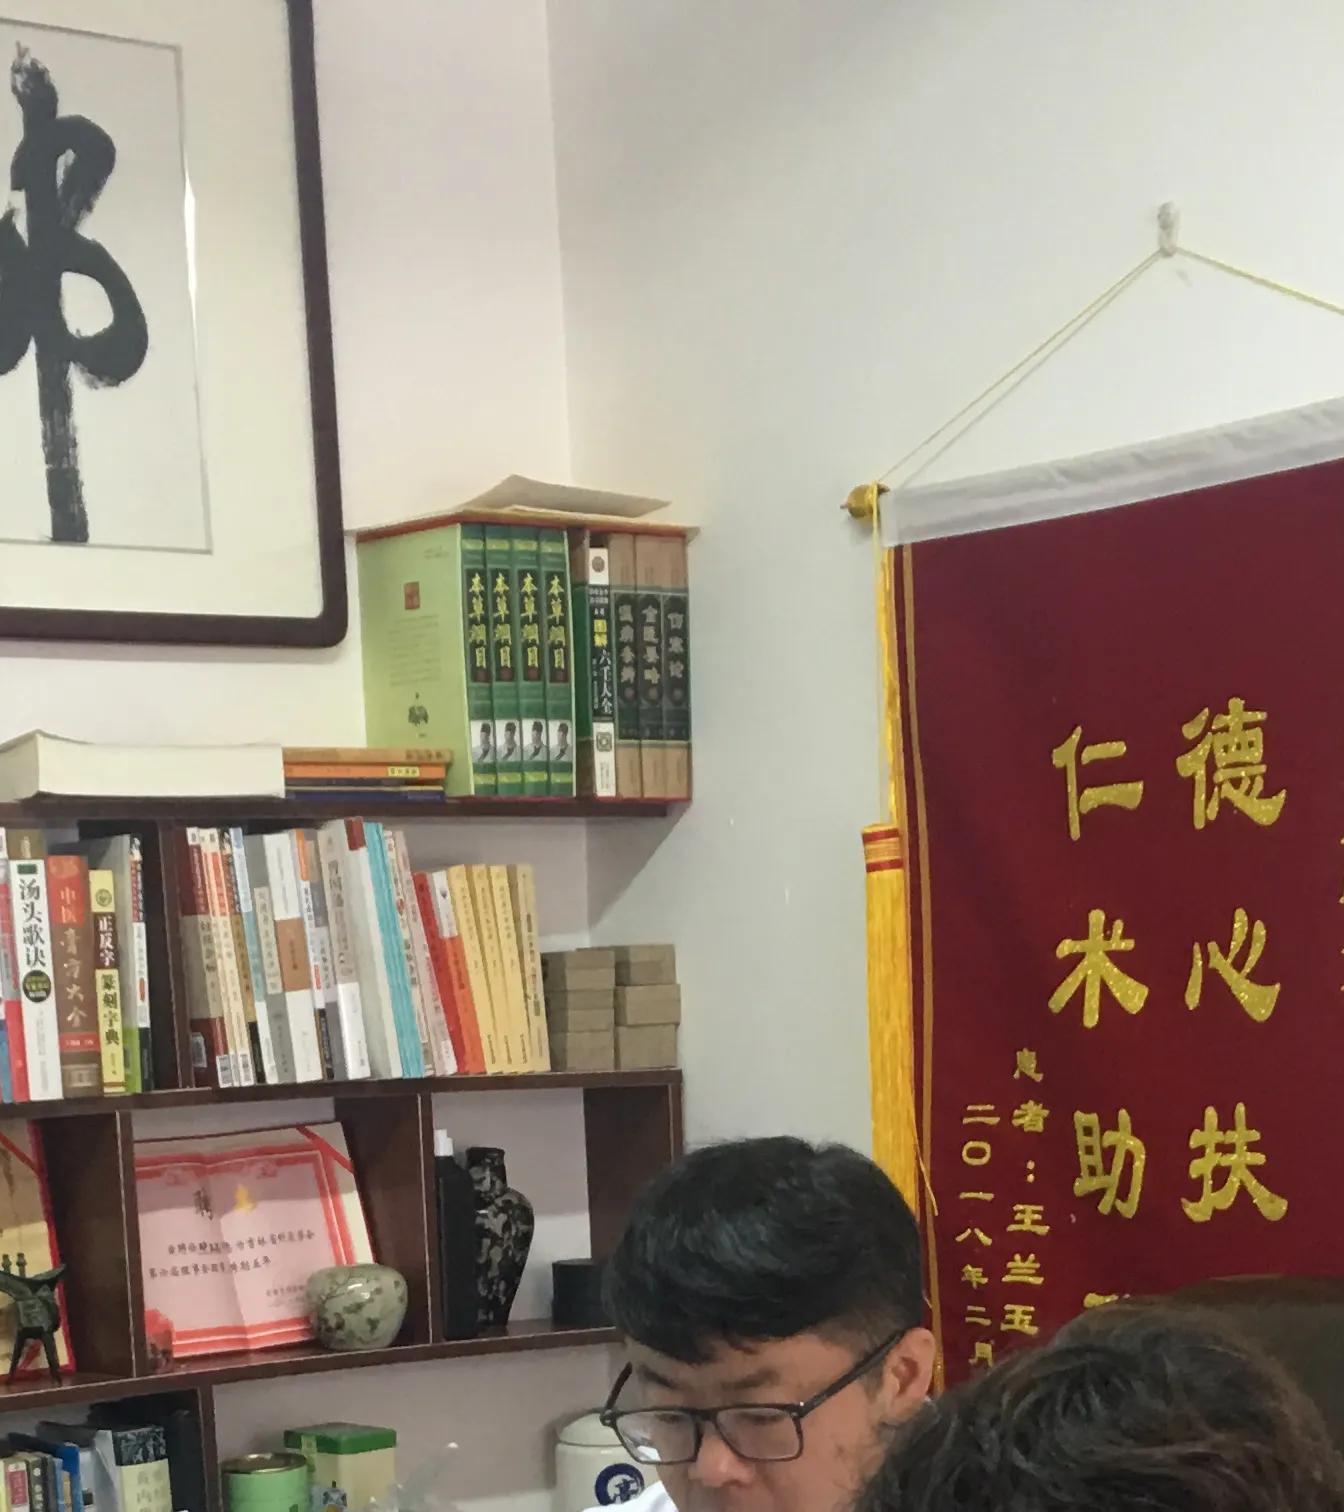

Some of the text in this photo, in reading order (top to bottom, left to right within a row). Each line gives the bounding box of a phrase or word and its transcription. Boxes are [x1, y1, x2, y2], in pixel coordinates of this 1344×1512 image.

[18, 878, 47, 968] 汤头歌诀
[1049, 725, 1150, 1308] 仁术助
